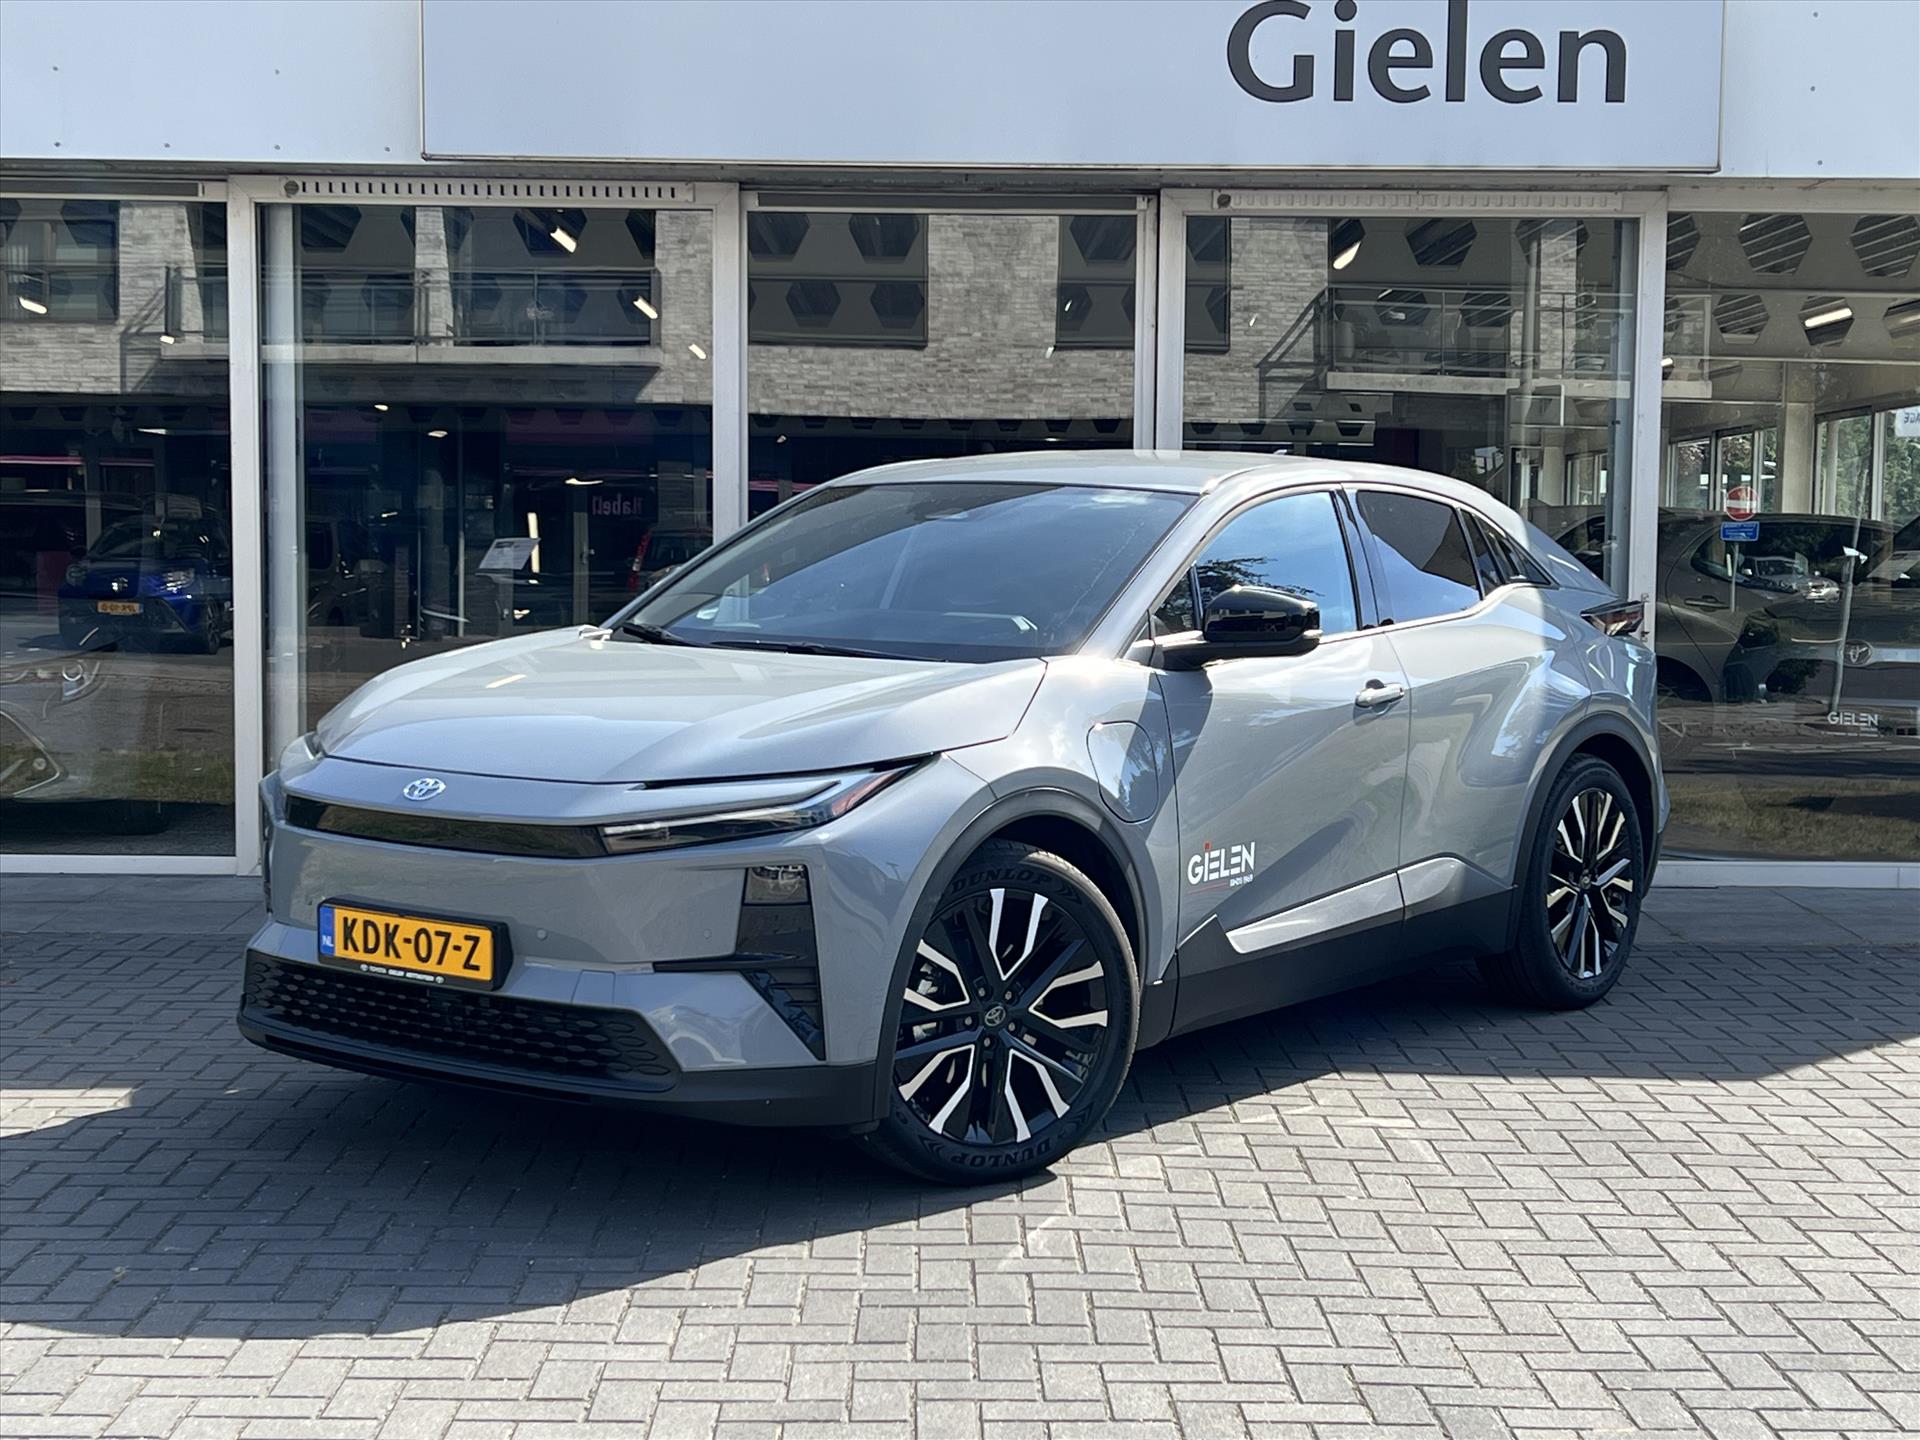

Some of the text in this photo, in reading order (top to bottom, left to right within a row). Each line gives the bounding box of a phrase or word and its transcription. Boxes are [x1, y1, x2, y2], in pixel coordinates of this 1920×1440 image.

[1227, 0, 1627, 103] Gielen
[1827, 711, 1879, 726] GIELEN
[1187, 841, 1256, 885] GIELEN
[951, 868, 1052, 893] DUNLOP
[321, 934, 334, 947] NL
[342, 916, 481, 971] KDK-07-Z
[951, 1137, 1051, 1168] DUNLOP
